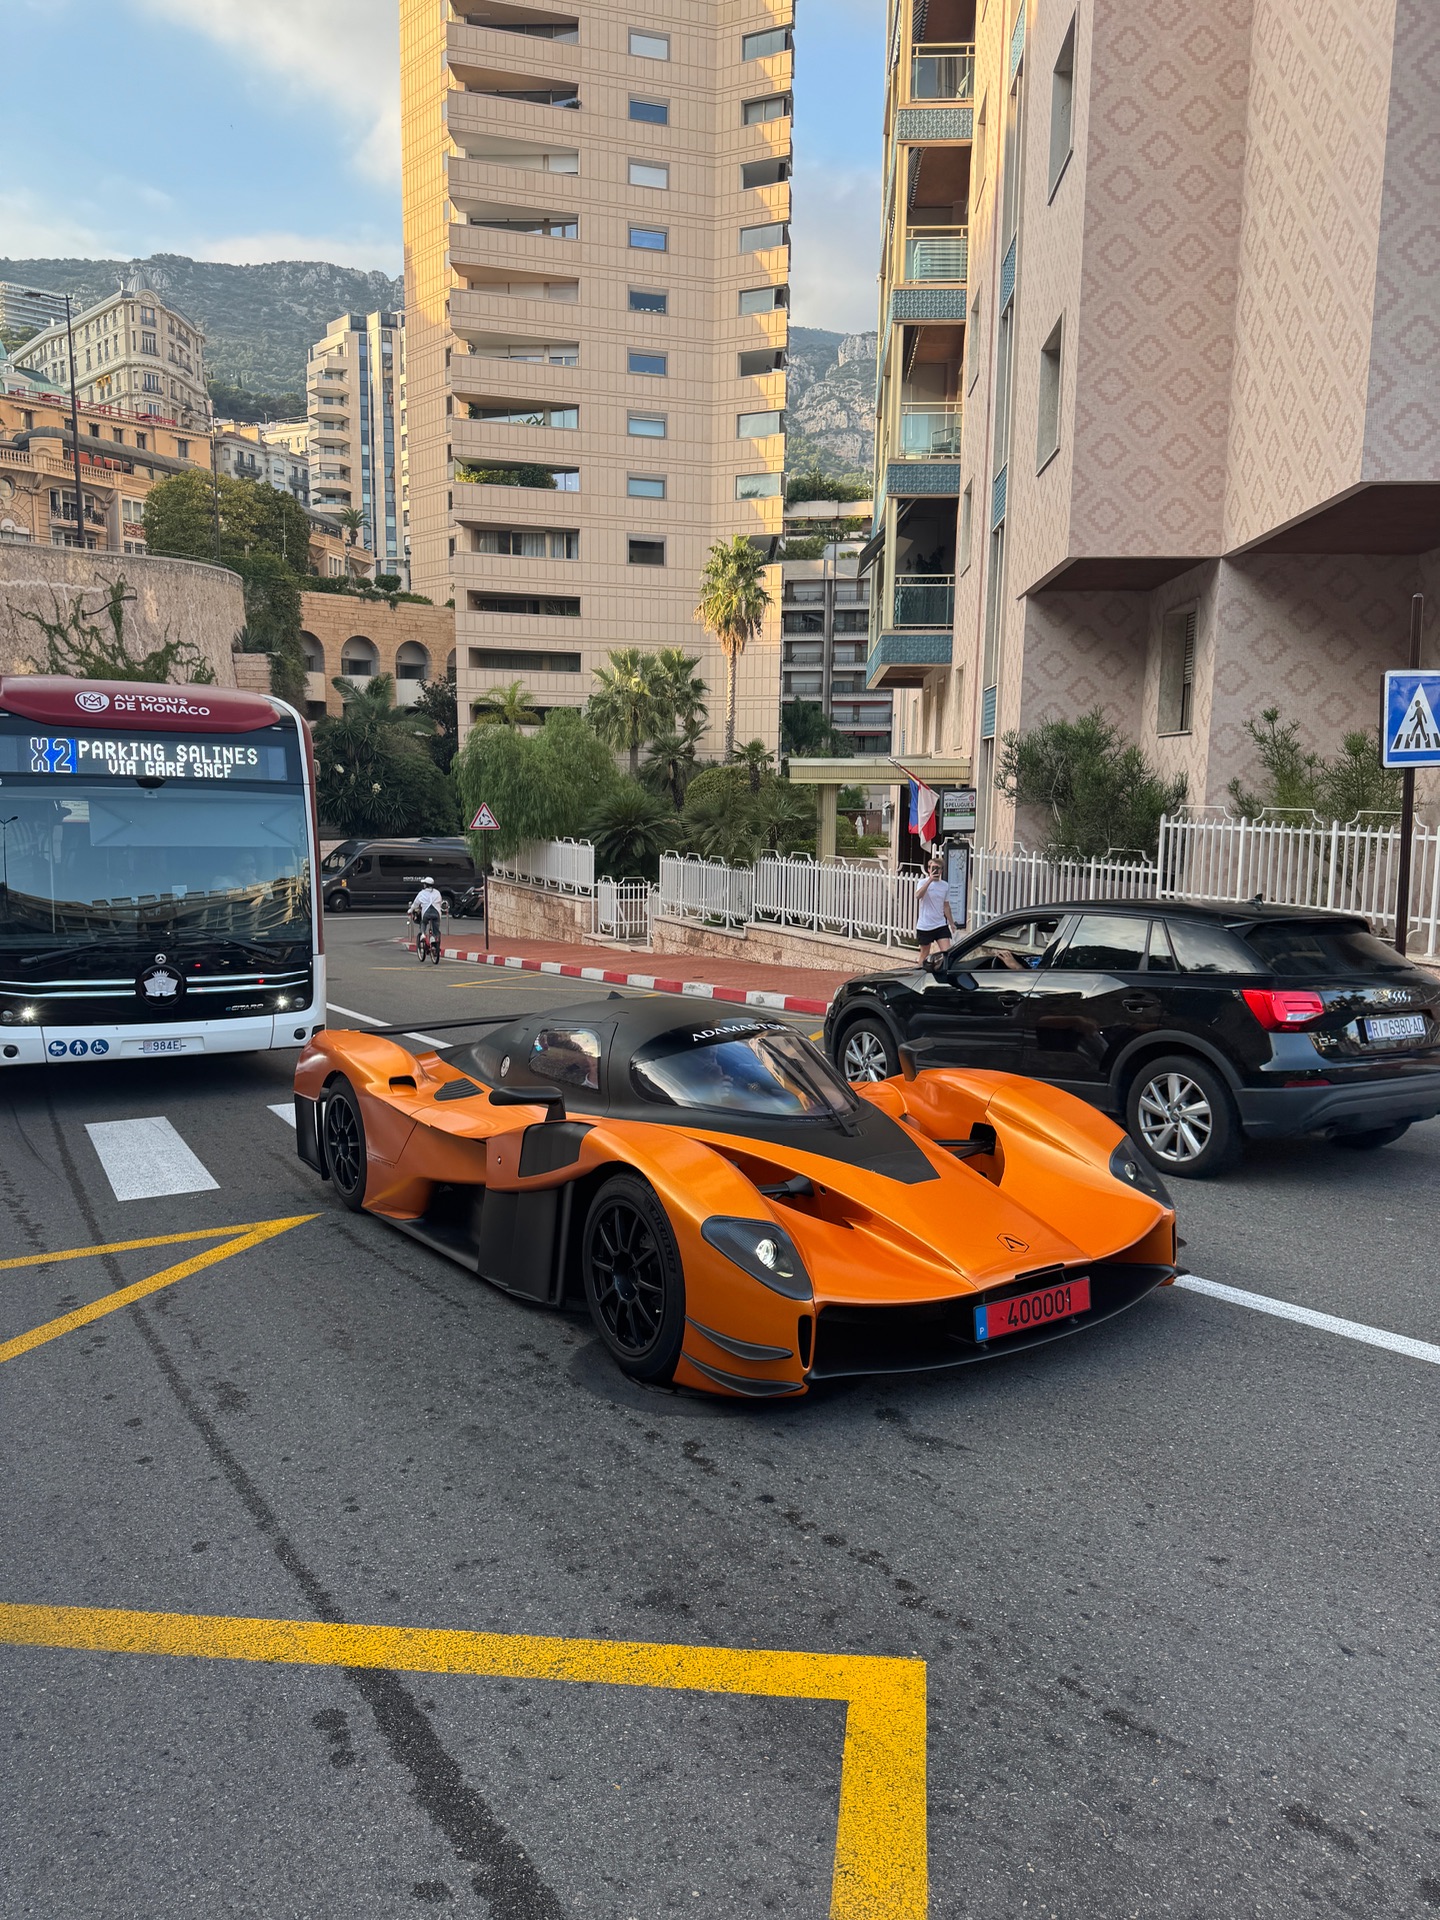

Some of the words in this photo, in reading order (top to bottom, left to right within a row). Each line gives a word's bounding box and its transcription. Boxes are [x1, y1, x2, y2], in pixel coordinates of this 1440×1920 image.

[113, 694, 188, 705] AUTOBUS
[114, 701, 136, 711] DE
[141, 703, 210, 716] MONACO
[30, 737, 72, 773] X2
[78, 740, 164, 762] PARKING
[176, 745, 258, 765] SALINES
[108, 759, 136, 776] VIA
[145, 761, 185, 777] GARE
[193, 763, 232, 779] SNCF
[692, 1023, 790, 1042] ADAMASTOR
[1371, 1021, 1383, 1037] RI
[153, 1040, 180, 1051] 984E
[1008, 1287, 1072, 1327] 400001
[979, 1326, 985, 1335] P
